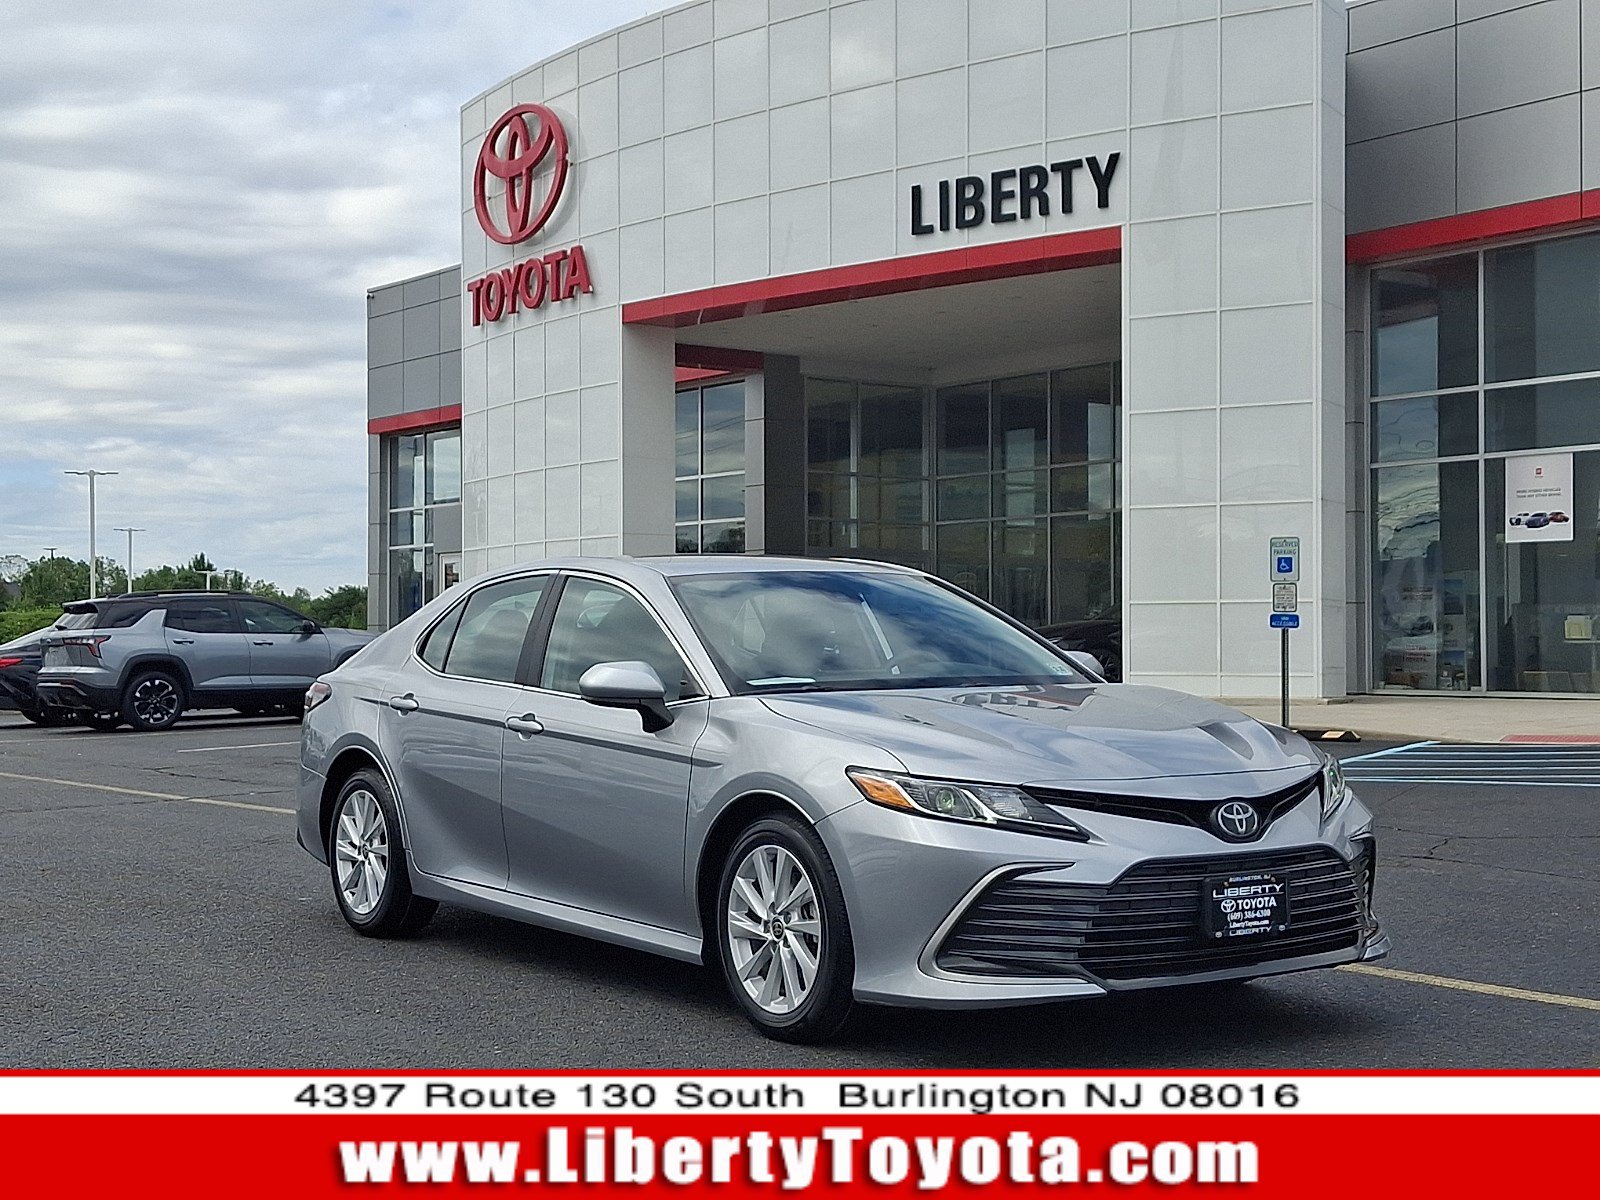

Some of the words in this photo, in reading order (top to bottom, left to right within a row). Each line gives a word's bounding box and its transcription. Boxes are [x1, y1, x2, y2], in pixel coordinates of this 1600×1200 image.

[911, 152, 1121, 236] LIBERTY
[467, 244, 594, 327] TOYOTA
[1213, 883, 1284, 898] LIBERTY
[1237, 896, 1277, 910] TOYOTA
[1229, 926, 1272, 936] LIBERTY
